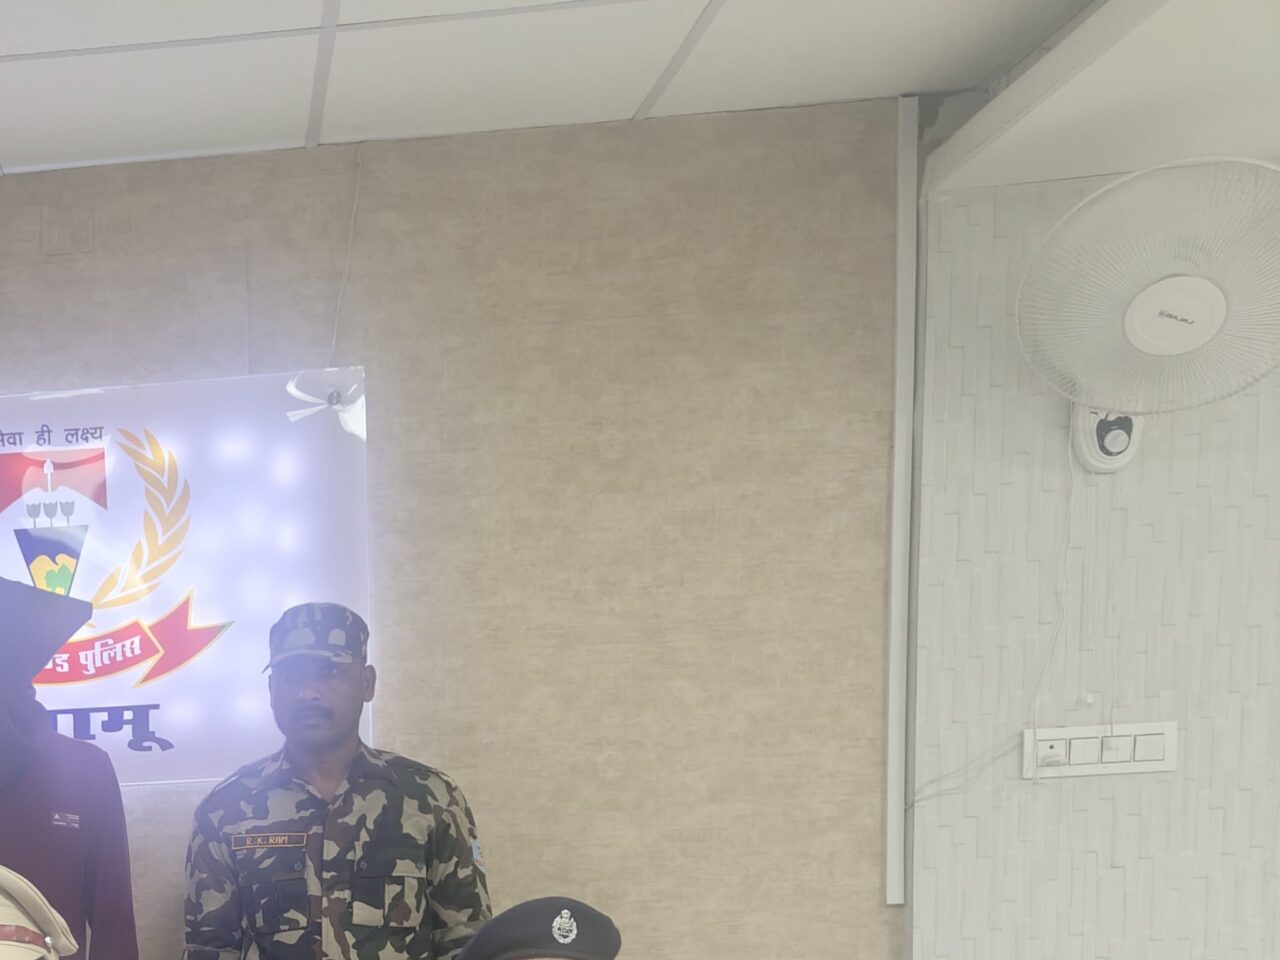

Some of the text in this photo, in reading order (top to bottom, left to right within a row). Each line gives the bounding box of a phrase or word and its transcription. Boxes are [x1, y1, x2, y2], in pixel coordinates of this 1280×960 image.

[35, 424, 53, 446] ही
[64, 426, 104, 443] लक्ष्य
[78, 635, 142, 675] पुलिस
